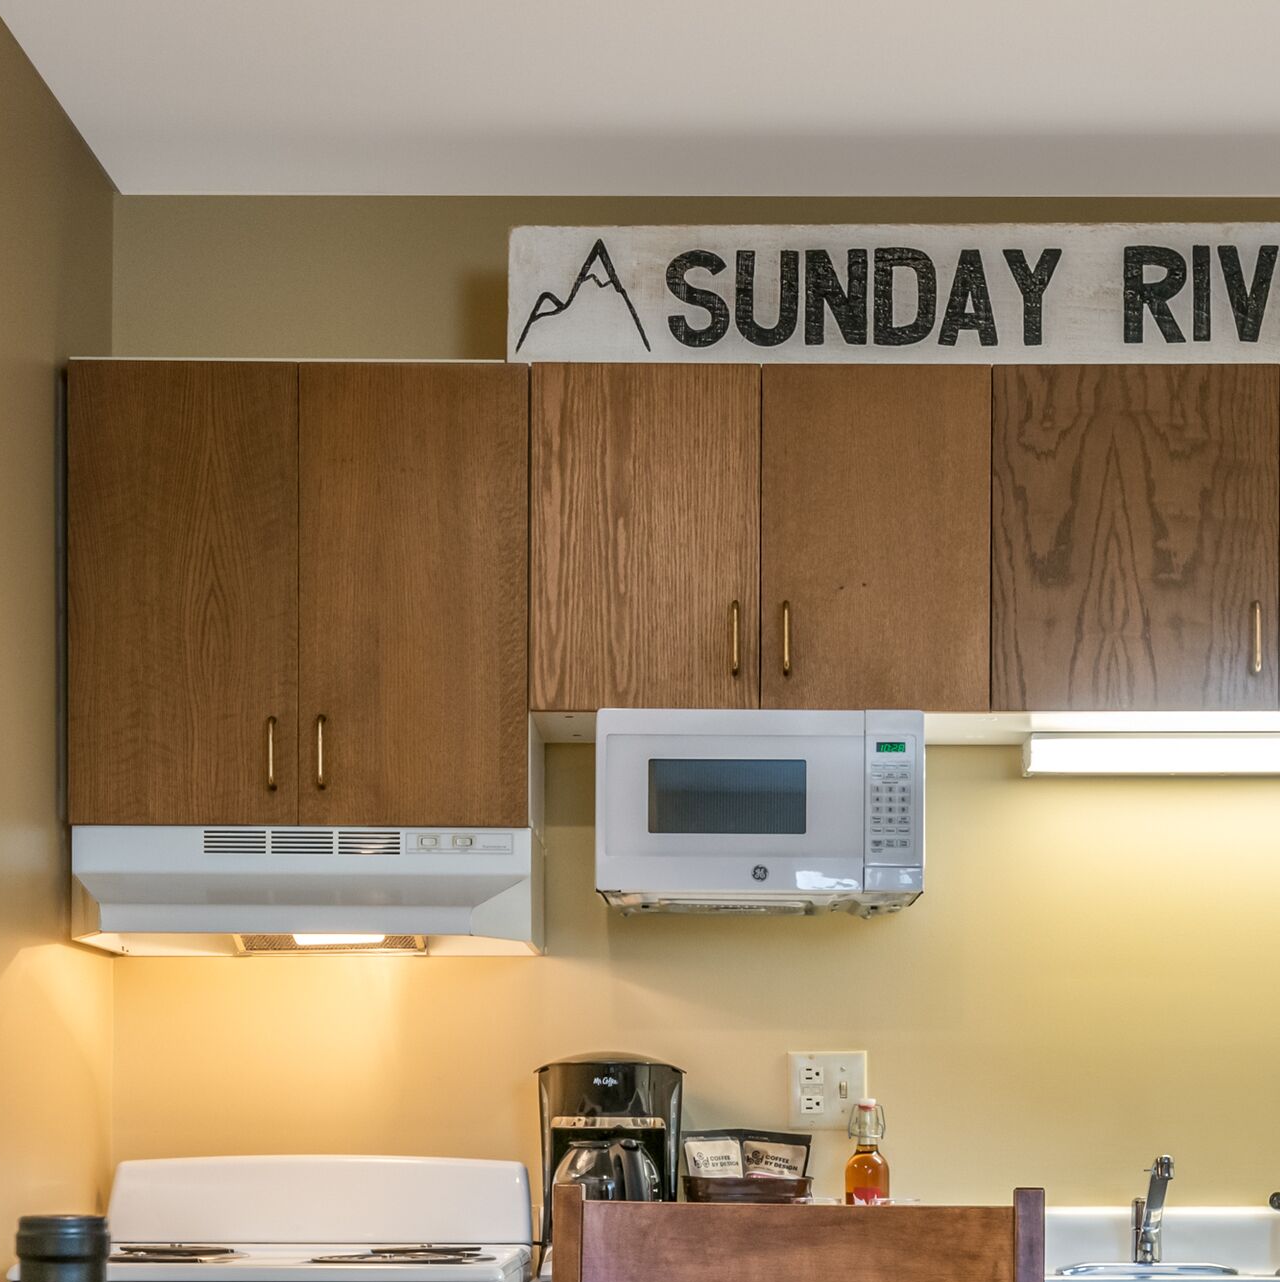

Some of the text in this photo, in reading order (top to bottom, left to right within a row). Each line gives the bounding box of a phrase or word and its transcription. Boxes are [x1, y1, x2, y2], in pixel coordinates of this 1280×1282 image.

[665, 246, 1063, 349] SUNDAY
[880, 743, 905, 753] 10:28
[765, 1154, 790, 1164] COFFEE
[774, 1162, 799, 1172] DESIGN
